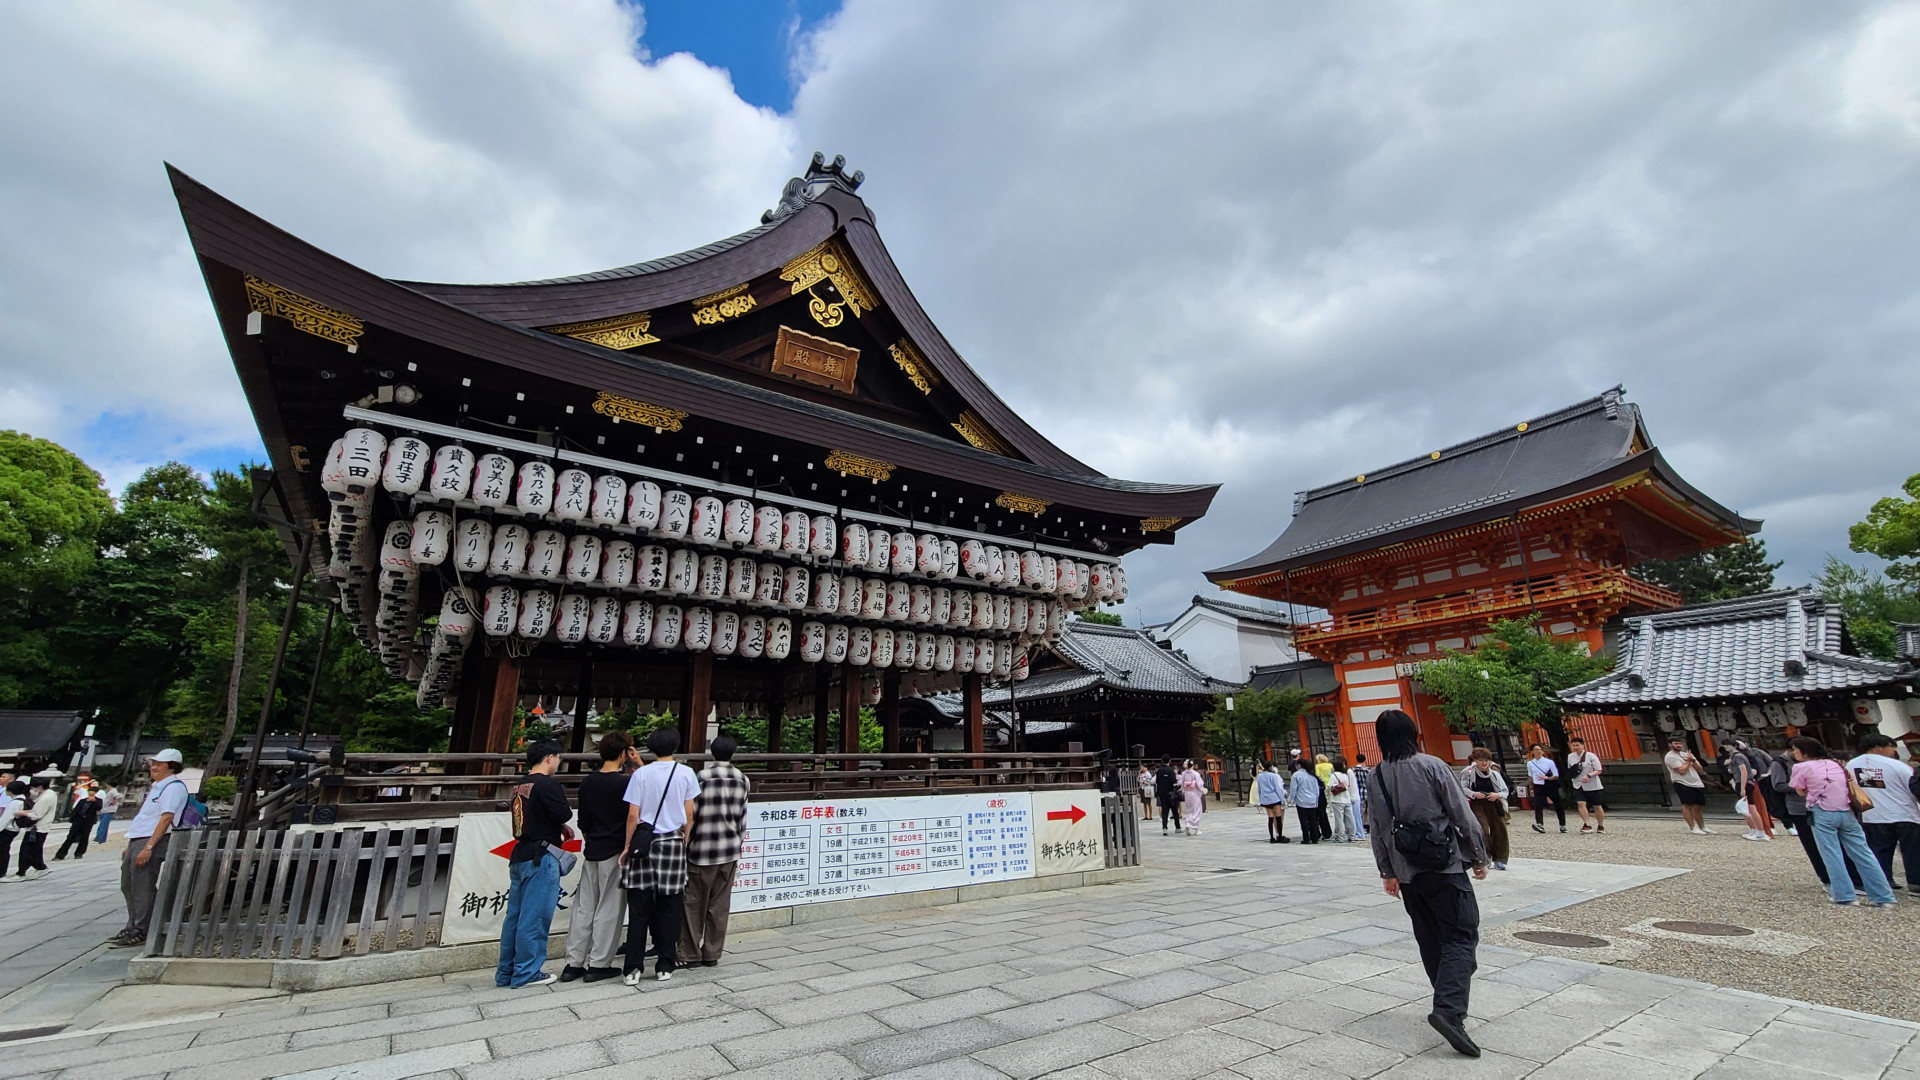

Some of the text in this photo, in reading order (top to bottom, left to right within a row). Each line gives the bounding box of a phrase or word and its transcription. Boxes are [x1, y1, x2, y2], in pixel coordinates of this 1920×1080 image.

[348, 447, 371, 478] 三田
[395, 439, 420, 484] 家田荘子
[528, 463, 547, 506] 繁乃家
[565, 471, 584, 512] 富美代
[638, 482, 657, 520] いし初
[668, 493, 687, 533] 堀八重
[703, 501, 720, 538] 利きみ
[421, 511, 439, 559] ゑり善
[464, 521, 481, 569] ゑり善
[500, 526, 517, 571] ゑり善
[878, 532, 889, 568] まつもと
[539, 531, 557, 577] ゑり善
[577, 536, 595, 578] ゑり善
[648, 546, 663, 588] 松井本館
[993, 548, 1004, 576] えん
[795, 569, 808, 604] 富久家
[898, 585, 909, 613] 小花
[920, 587, 930, 616] 市光
[494, 586, 511, 632] あおぞら印刷
[529, 590, 547, 636] あおぞら印刷
[567, 596, 582, 641] あおぞら印刷
[598, 597, 615, 641] あおぞら印刷
[632, 601, 648, 644] あおぞら印刷
[695, 607, 709, 645] 井上文太
[884, 631, 892, 662] 森トラスト
[760, 806, 867, 822] 令和8年 厄年表 (数え年)
[826, 819, 950, 834] 女性 前厄 本厄 後厄
[767, 838, 806, 851] 平成13年生
[779, 828, 797, 838] 後厄
[826, 830, 959, 848] 19歳 平成21年生 平成20年生 平成19年生
[1041, 838, 1098, 860] 御朱印受付
[767, 856, 806, 868] 昭和59年生
[824, 845, 957, 864] 33歳 平成7年生 平成6年生 平成5年生
[824, 858, 959, 879] 37歳 平成3年生 平成2年生 平成元年生
[766, 872, 805, 884] 昭和40年生
